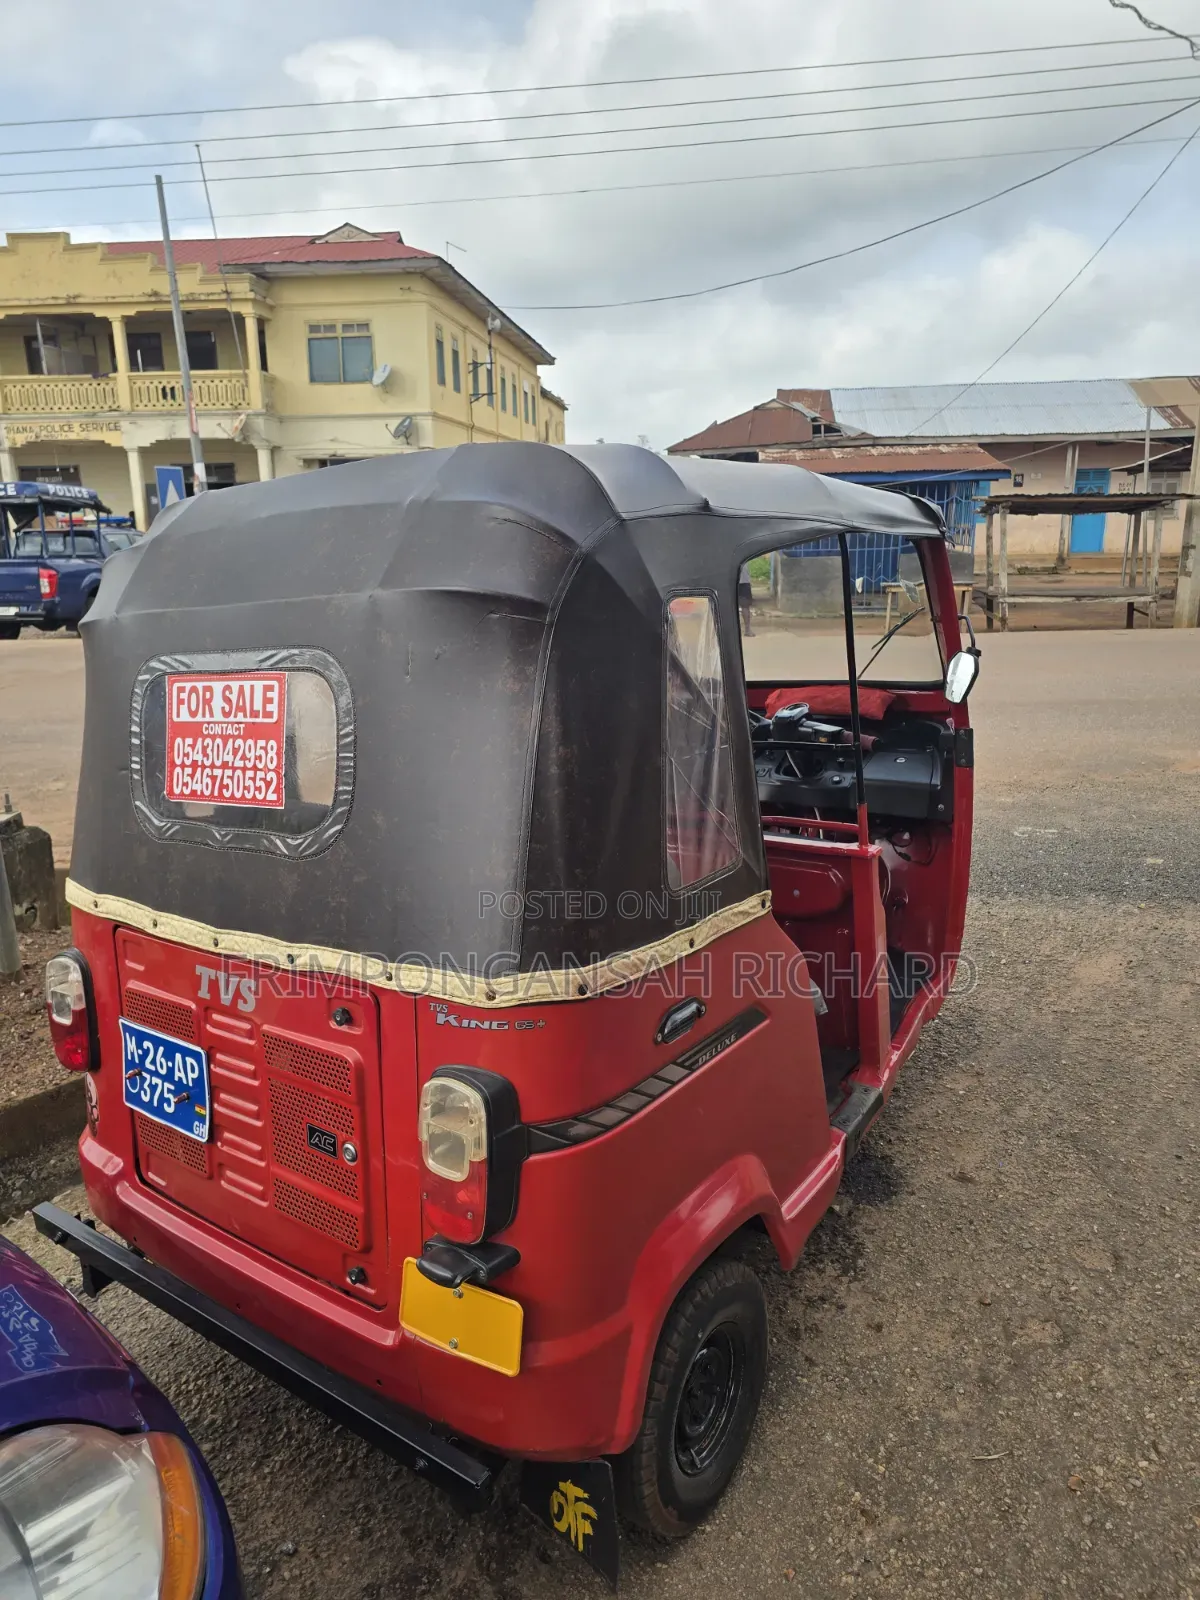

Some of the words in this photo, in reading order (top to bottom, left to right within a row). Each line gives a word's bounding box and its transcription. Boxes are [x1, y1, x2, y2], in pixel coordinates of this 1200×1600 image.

[39, 423, 74, 433] POLICE
[79, 422, 121, 433] SERVICE
[47, 484, 89, 498] POLICE
[175, 686, 214, 718] FOR
[221, 684, 275, 718] SALE
[202, 723, 245, 736] CONTACT
[173, 738, 277, 769] 0543042958
[173, 767, 277, 801] 0546750552
[195, 964, 256, 1012] TVS
[429, 1002, 449, 1013] TVS
[435, 1012, 509, 1030] KING
[125, 1032, 199, 1087] M-26-AP
[698, 1032, 738, 1066] DELUXE
[192, 1120, 206, 1138] GH
[310, 1131, 335, 1152] AC
